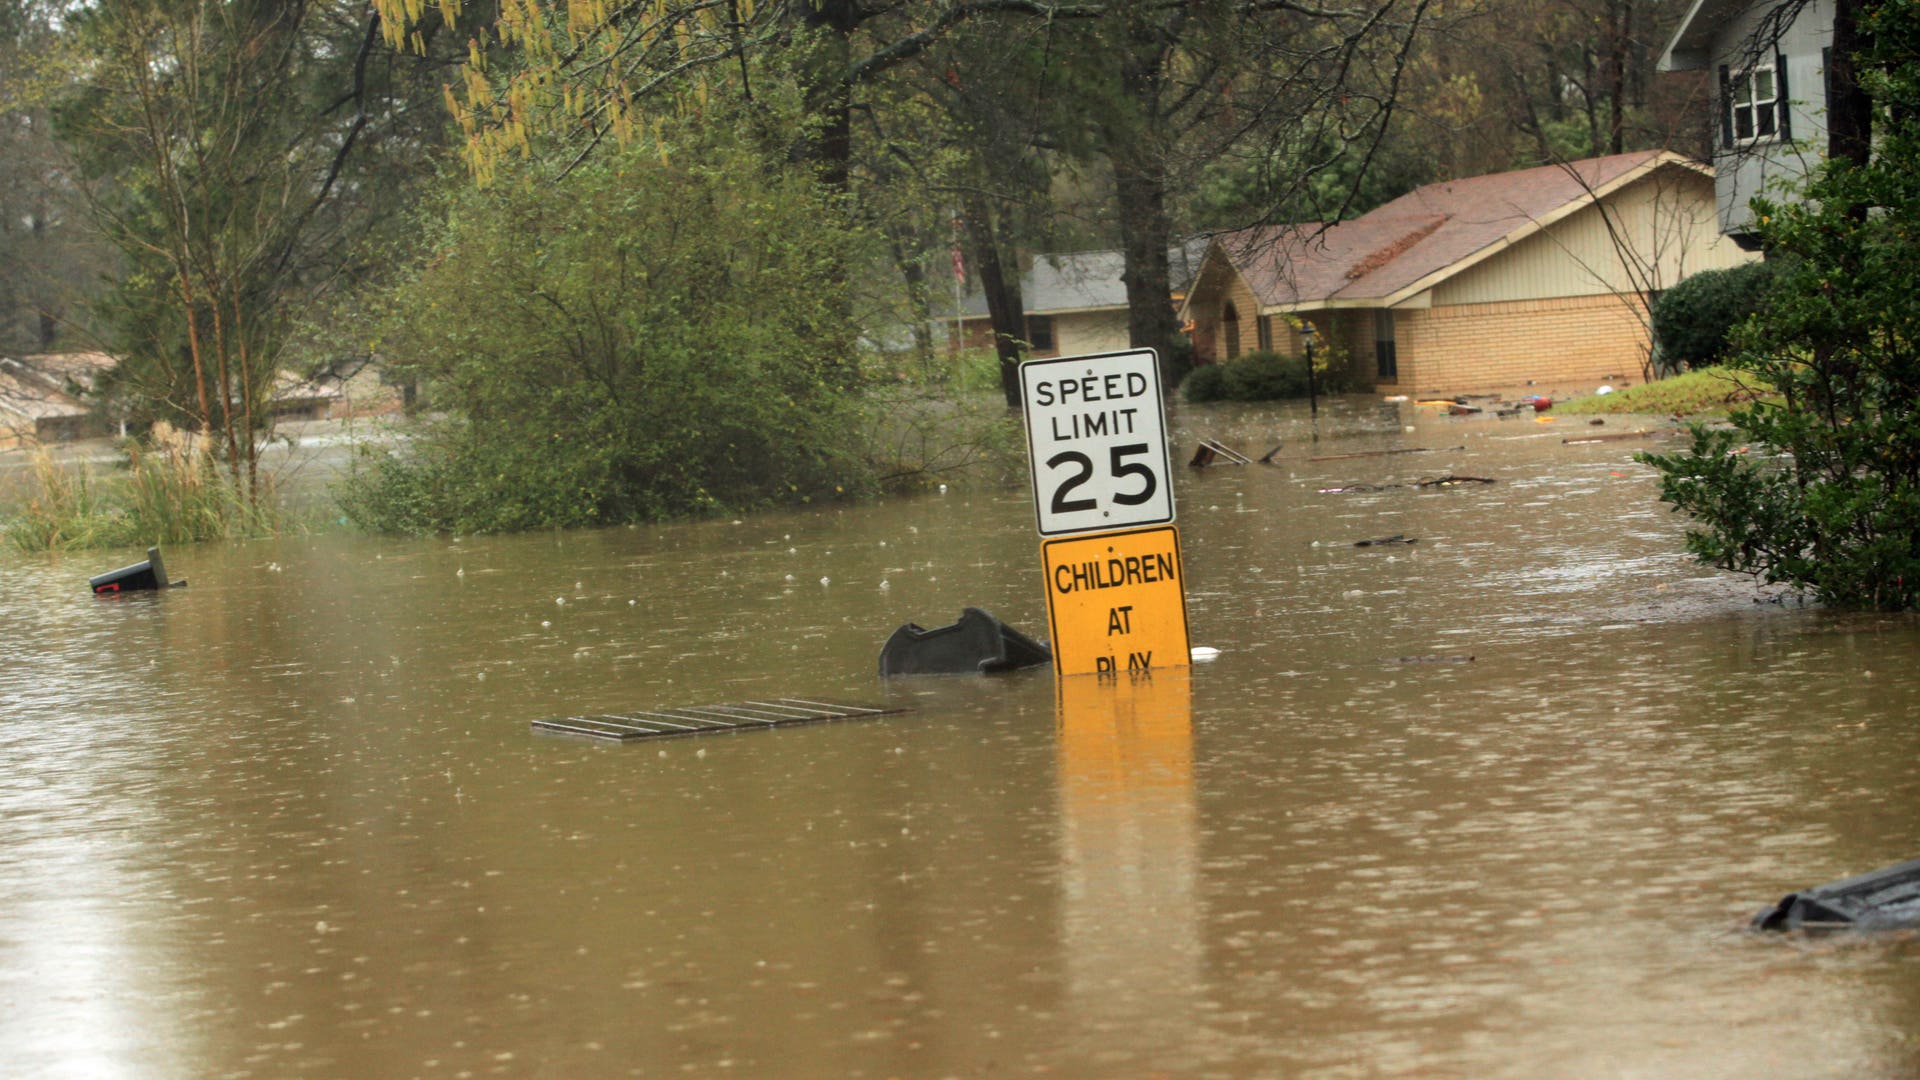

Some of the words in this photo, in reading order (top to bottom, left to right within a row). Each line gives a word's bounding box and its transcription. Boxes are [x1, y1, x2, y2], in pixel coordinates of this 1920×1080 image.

[1036, 372, 1147, 406] SPEED
[1052, 408, 1138, 441] LIMIT
[1046, 443, 1157, 514] 25
[1055, 552, 1175, 594] CHILDREN
[1108, 605, 1133, 636] AT
